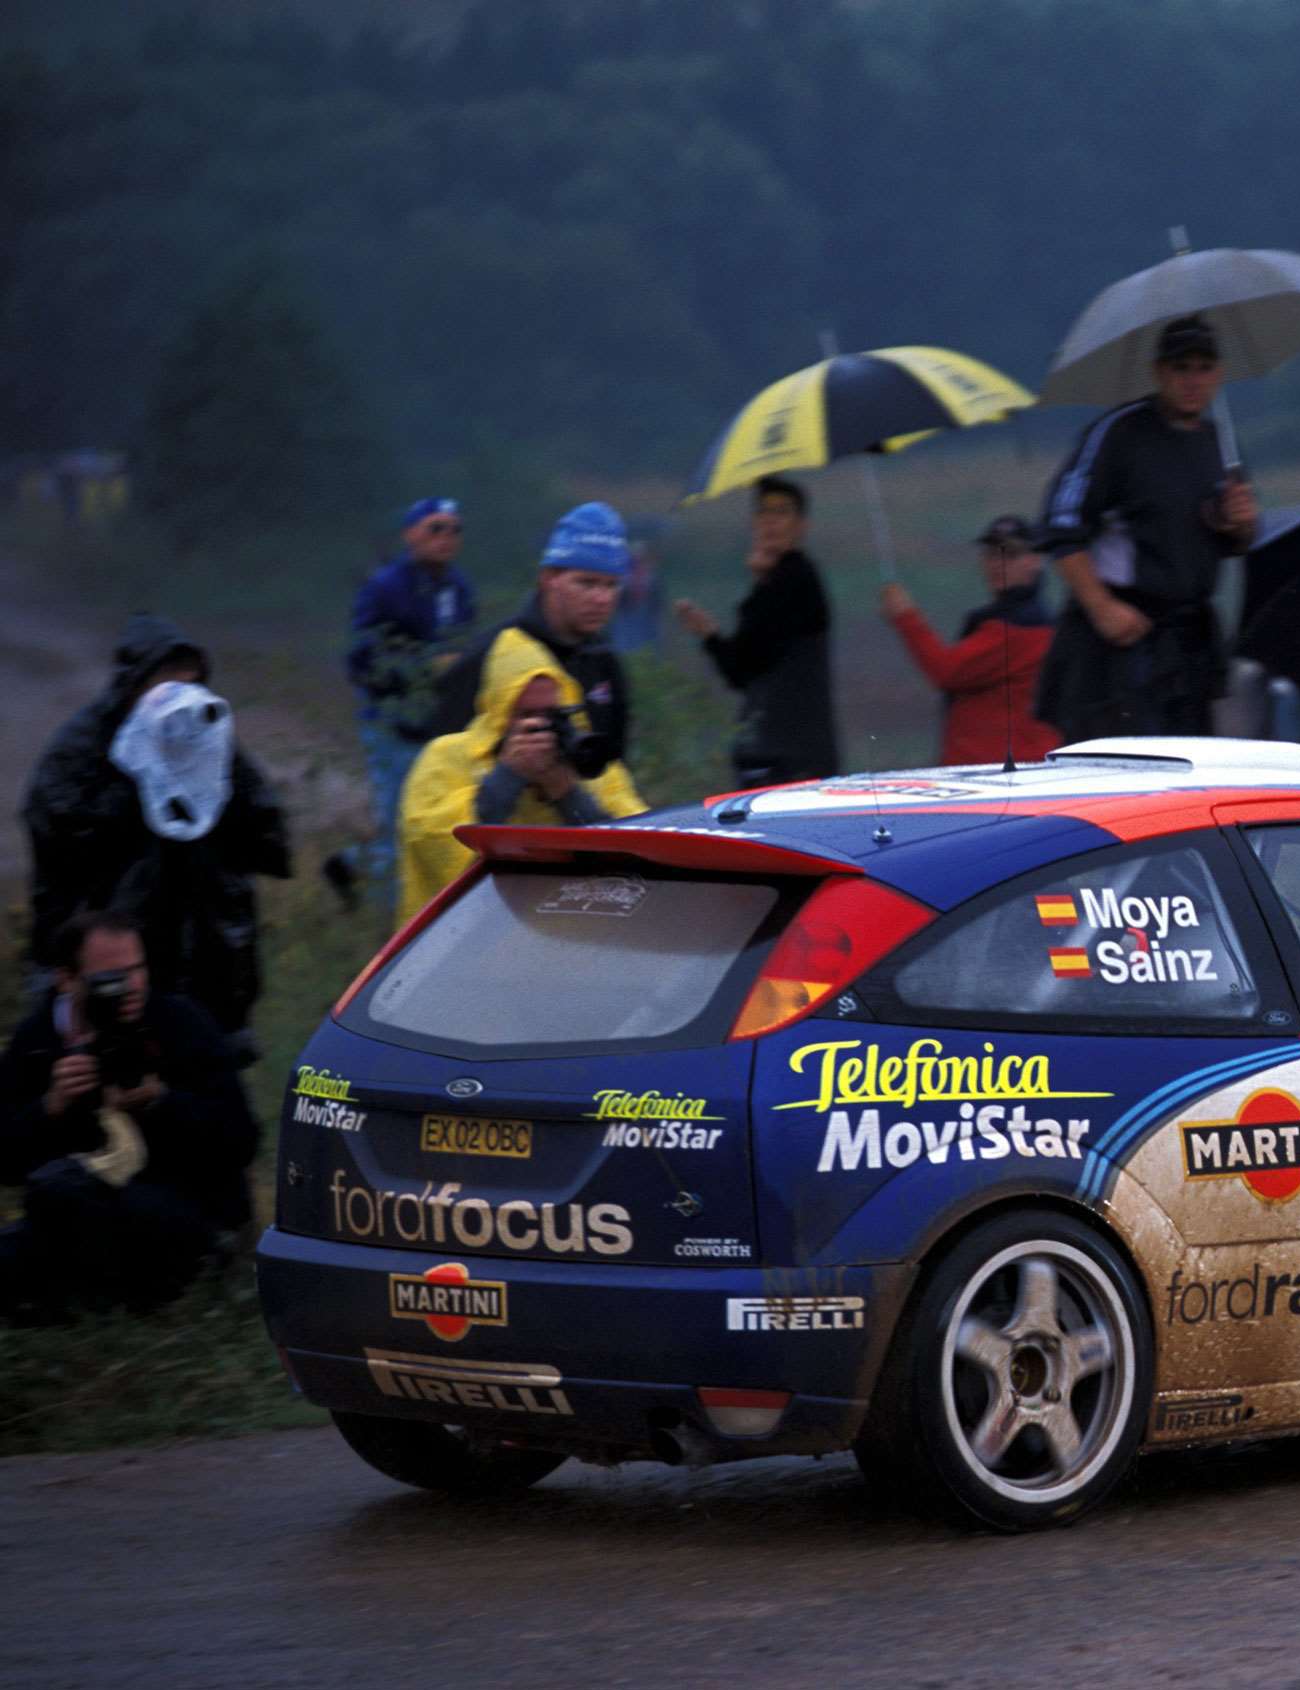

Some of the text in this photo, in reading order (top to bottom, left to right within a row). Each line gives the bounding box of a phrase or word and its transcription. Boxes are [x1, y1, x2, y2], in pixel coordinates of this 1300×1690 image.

[1079, 888, 1199, 940] Moya
[1097, 941, 1218, 984] Sainz
[293, 1096, 368, 1132] MoviStar
[486, 1121, 529, 1154] OBC
[602, 1119, 723, 1150] MoviStar
[816, 1102, 1090, 1173] MoviStar
[329, 1169, 635, 1256] fordfocus
[674, 1244, 752, 1258] COSWORTH
[396, 1283, 499, 1316] MARTINI
[726, 1297, 865, 1331] PIRELLI
[363, 1347, 574, 1416] PIRELLI
[1156, 1394, 1243, 1431] PIRELLI
